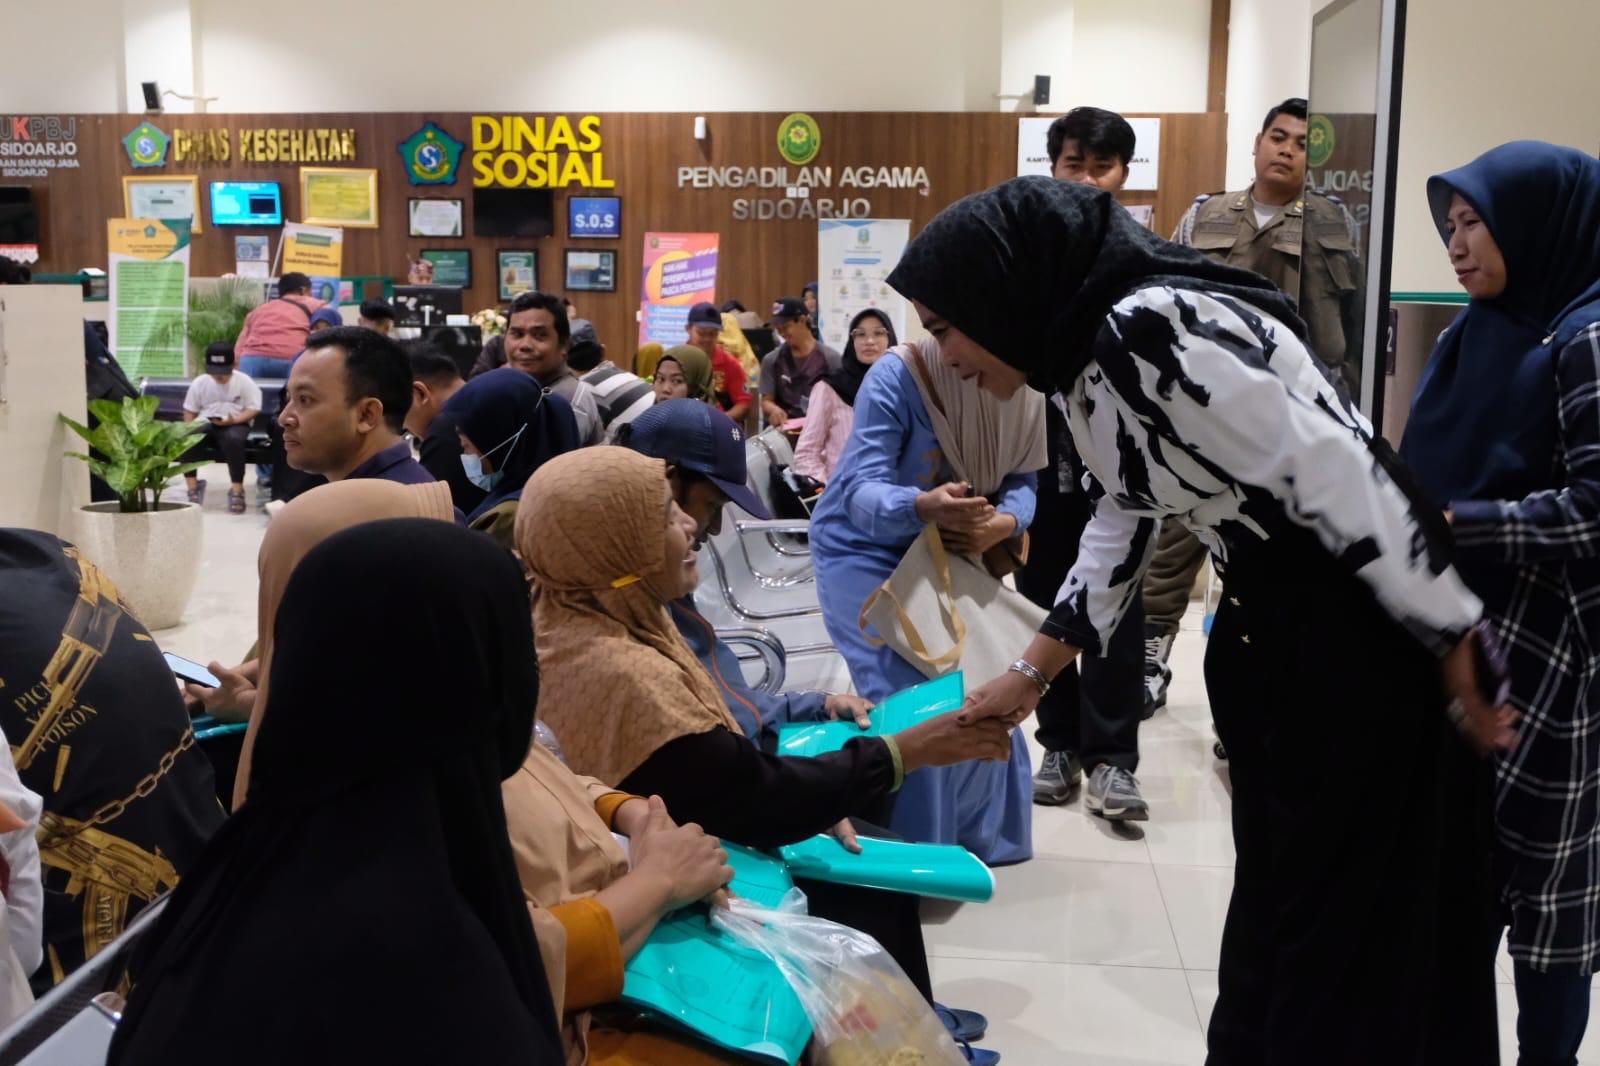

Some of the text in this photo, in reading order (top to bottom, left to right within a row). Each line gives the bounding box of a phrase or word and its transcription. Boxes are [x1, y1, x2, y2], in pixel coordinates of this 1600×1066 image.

[0, 115, 76, 141] UKPBJ
[472, 115, 602, 152] DINAS
[0, 141, 77, 156] SIDOARJO
[173, 128, 355, 162] DINAS KESEHATAN
[472, 151, 615, 188] SOSIAL
[677, 166, 929, 188] PENGADILAN AGAMA
[575, 213, 615, 229] S.O.S
[732, 198, 871, 220] SIDOARJO
